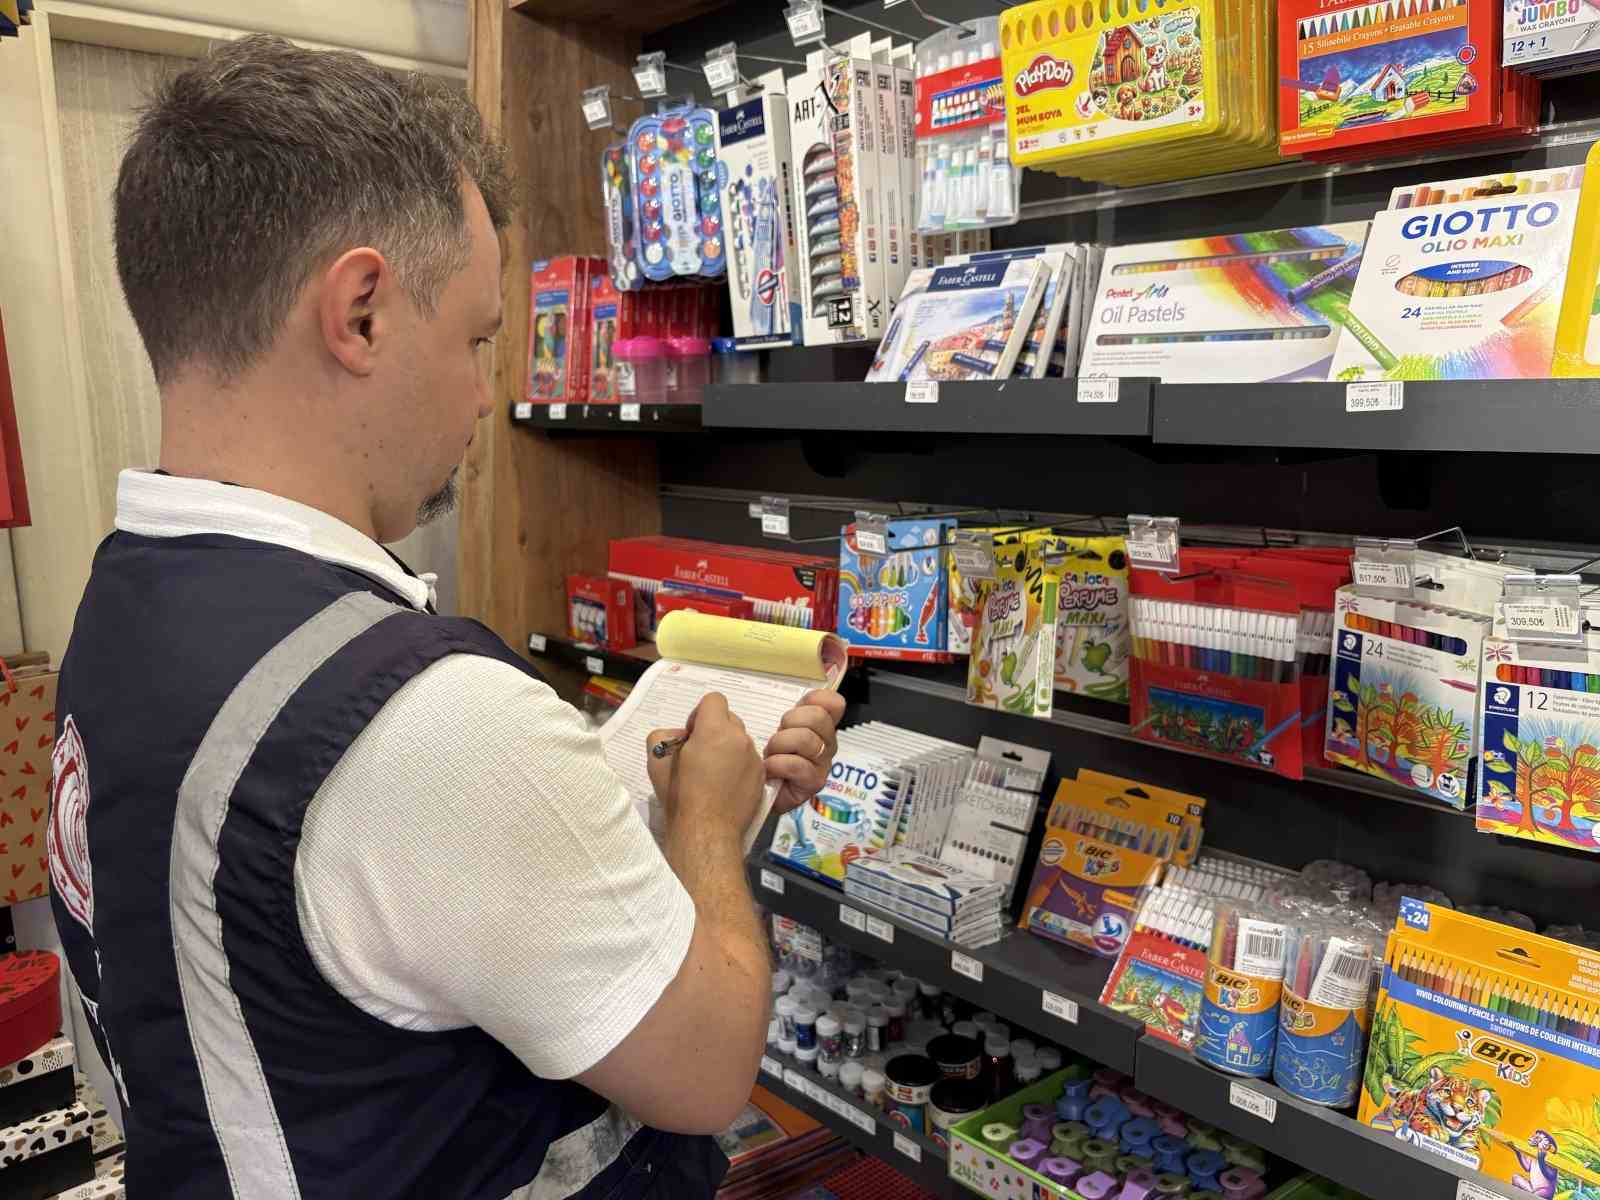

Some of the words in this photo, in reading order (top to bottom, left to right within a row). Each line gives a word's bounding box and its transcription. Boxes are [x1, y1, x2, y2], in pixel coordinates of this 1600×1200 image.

[1518, 0, 1580, 25] JUMBO
[1303, 42, 1314, 56] 15
[1352, 28, 1384, 41] Crayons
[1390, 20, 1421, 33] Erasable
[1423, 13, 1455, 26] Crayons
[1520, 24, 1537, 32] WAX
[1538, 16, 1576, 30] CRAYONS
[1511, 40, 1525, 53] 12
[1528, 40, 1536, 49] +
[1540, 36, 1547, 48] 1
[1015, 59, 1072, 94] Play-Doh
[1016, 112, 1038, 126] MUM
[1038, 109, 1063, 122] BOYA
[1187, 105, 1202, 117] 3+
[670, 173, 682, 222] GIOTTO
[1400, 201, 1560, 241] GIOTTO
[1420, 236, 1467, 255] OLIO
[1470, 233, 1525, 251] MAXI
[1100, 304, 1124, 325] Oil
[1127, 302, 1185, 324] Pastels
[1400, 306, 1423, 320] 24
[1366, 639, 1384, 658] 24
[1527, 690, 1549, 711] 12
[831, 761, 878, 790] OTTO
[1407, 910, 1429, 927] x24
[1416, 988, 1432, 1001] VIVID
[1432, 994, 1468, 1013] COLOURING
[1468, 1005, 1495, 1023] PENCILS
[1499, 1013, 1530, 1034] CRAYONS
[1530, 1026, 1540, 1036] DE
[1539, 1029, 1571, 1048] COULEUR
